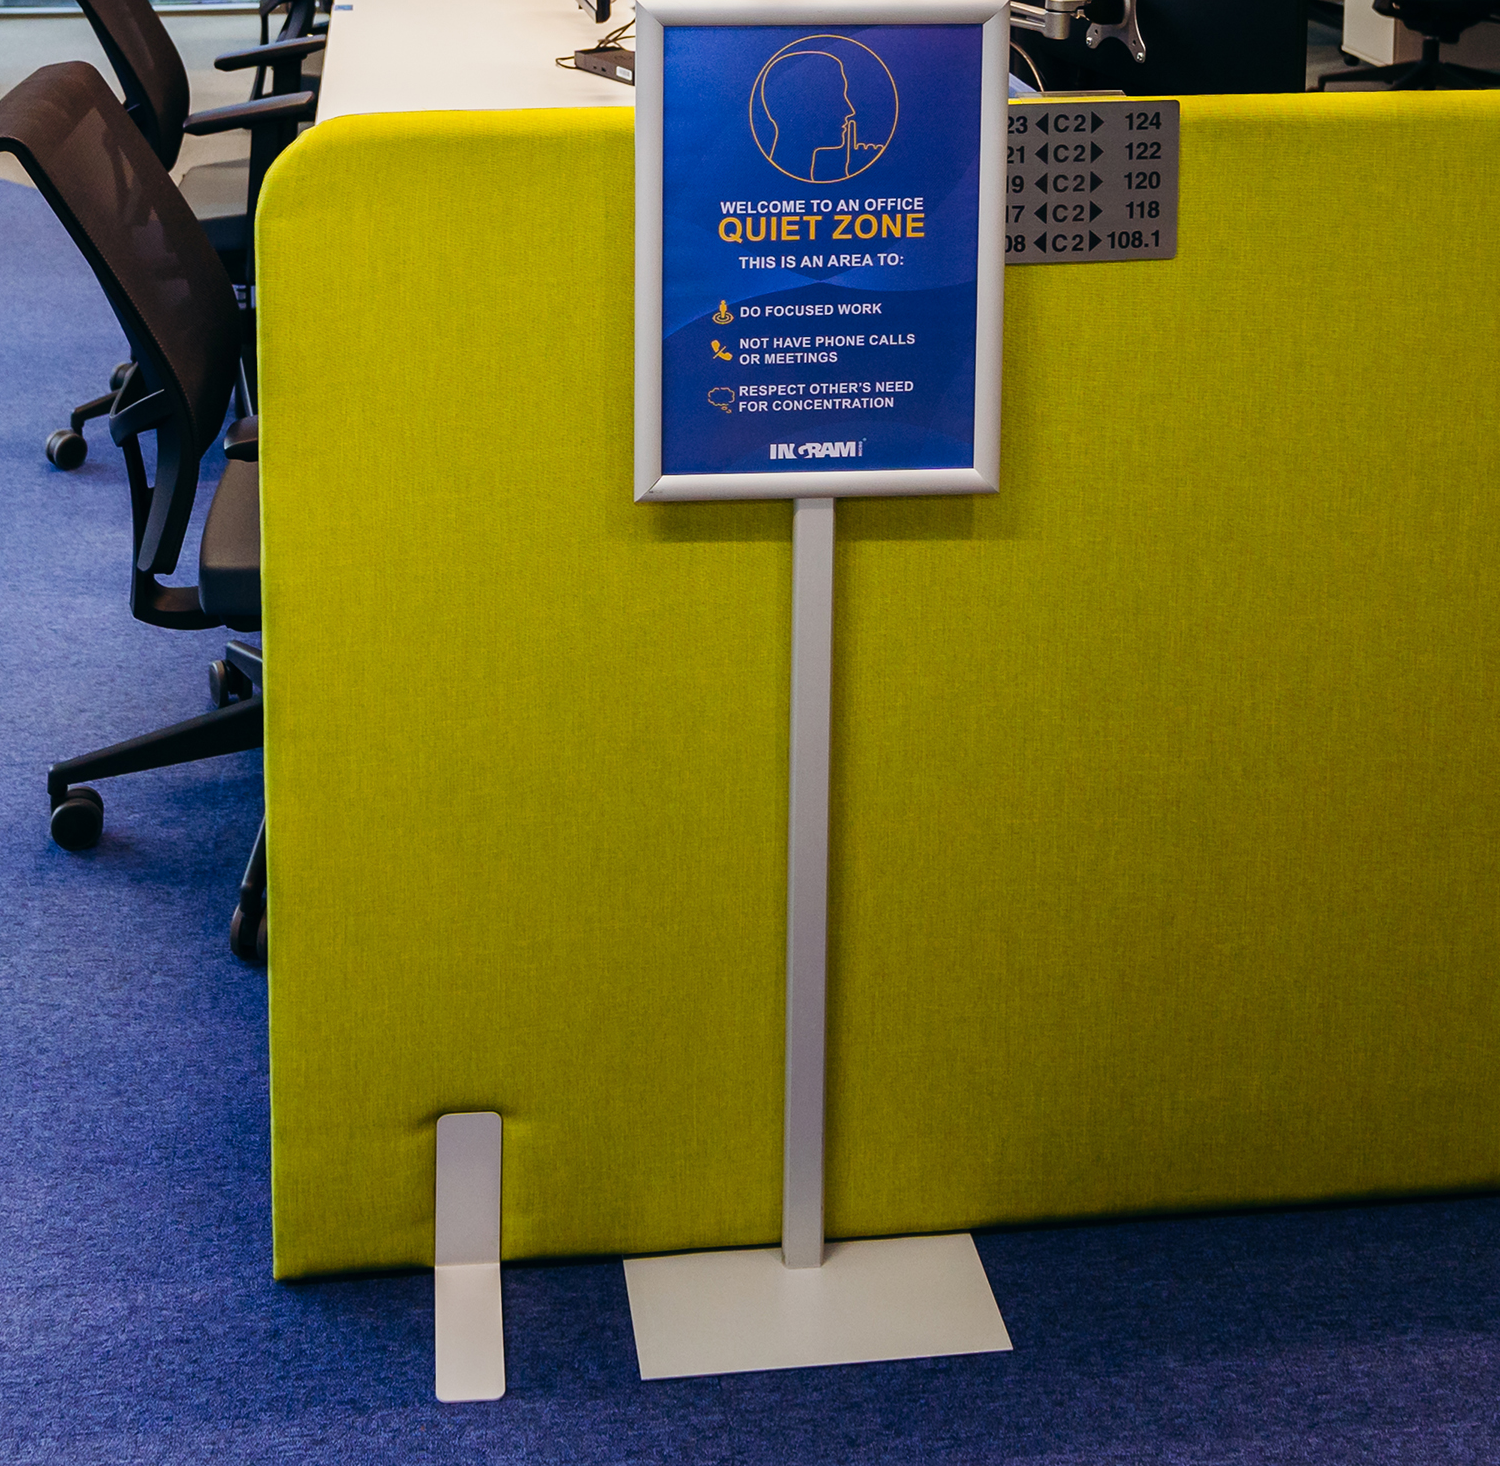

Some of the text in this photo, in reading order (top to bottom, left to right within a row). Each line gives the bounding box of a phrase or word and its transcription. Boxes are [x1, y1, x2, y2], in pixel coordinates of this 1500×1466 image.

[1125, 111, 1162, 131] 124
[1125, 141, 1162, 160] 122
[1124, 171, 1161, 190] 120
[720, 197, 924, 214] WELCOME TO AN OFFICE
[1125, 201, 1160, 219] 118
[718, 213, 926, 244] QUIET ZONE
[1107, 230, 1161, 249] 108.1
[739, 252, 905, 269] THIS IS AN AREA TO:
[740, 302, 883, 318] DO FOCUSED WORK
[739, 333, 916, 349] NOT HAVE PHONE CALLS
[739, 351, 838, 366] OR MEETINGS
[738, 384, 806, 397] RESPECT
[875, 381, 915, 394] NEED
[738, 397, 895, 413] FOR CONCENTRATION
